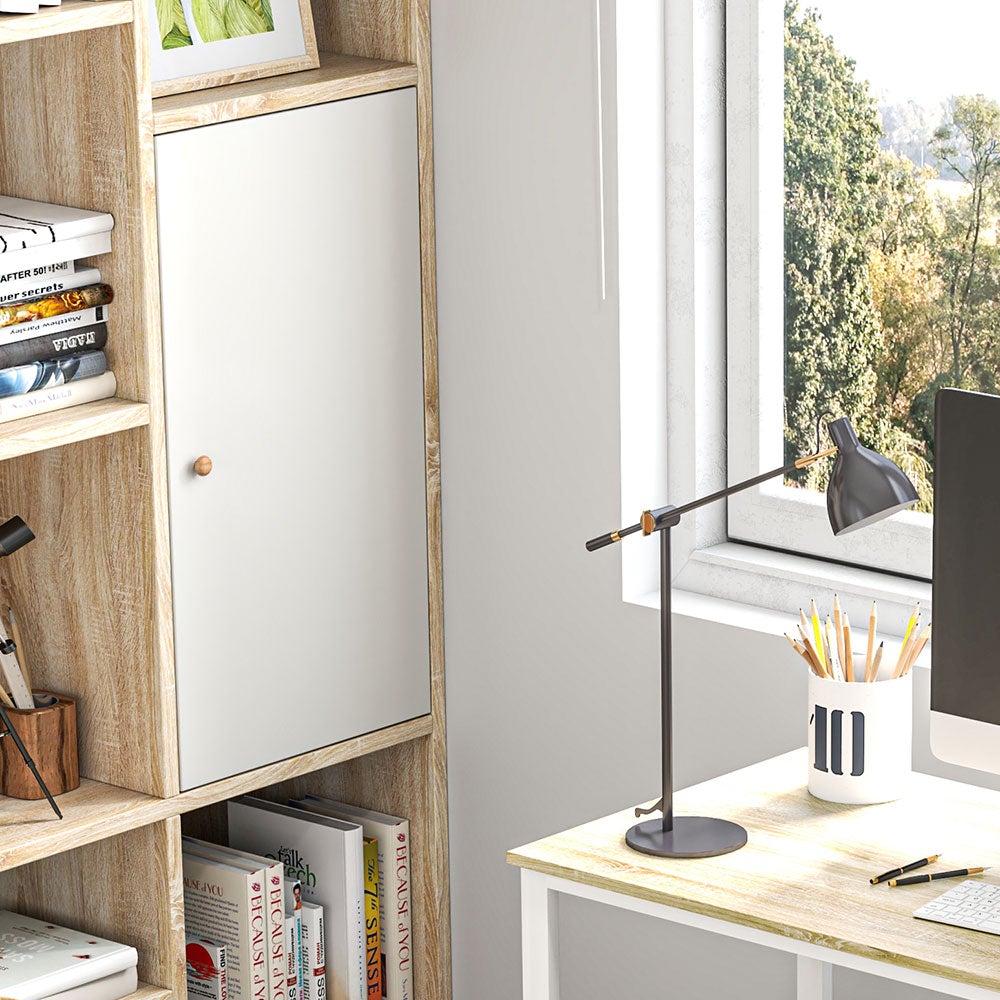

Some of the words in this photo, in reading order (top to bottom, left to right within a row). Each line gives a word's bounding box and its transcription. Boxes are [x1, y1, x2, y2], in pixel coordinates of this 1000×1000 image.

[21, 283, 64, 298] secrets
[278, 849, 304, 870] talk
[284, 863, 317, 888] ech
[396, 845, 408, 919] BECAUSE
[251, 895, 264, 971] BECAUSE
[270, 888, 283, 964] BECAUSE
[219, 948, 227, 968] FIND
[366, 917, 380, 996] SENSE
[398, 933, 410, 971] YOU
